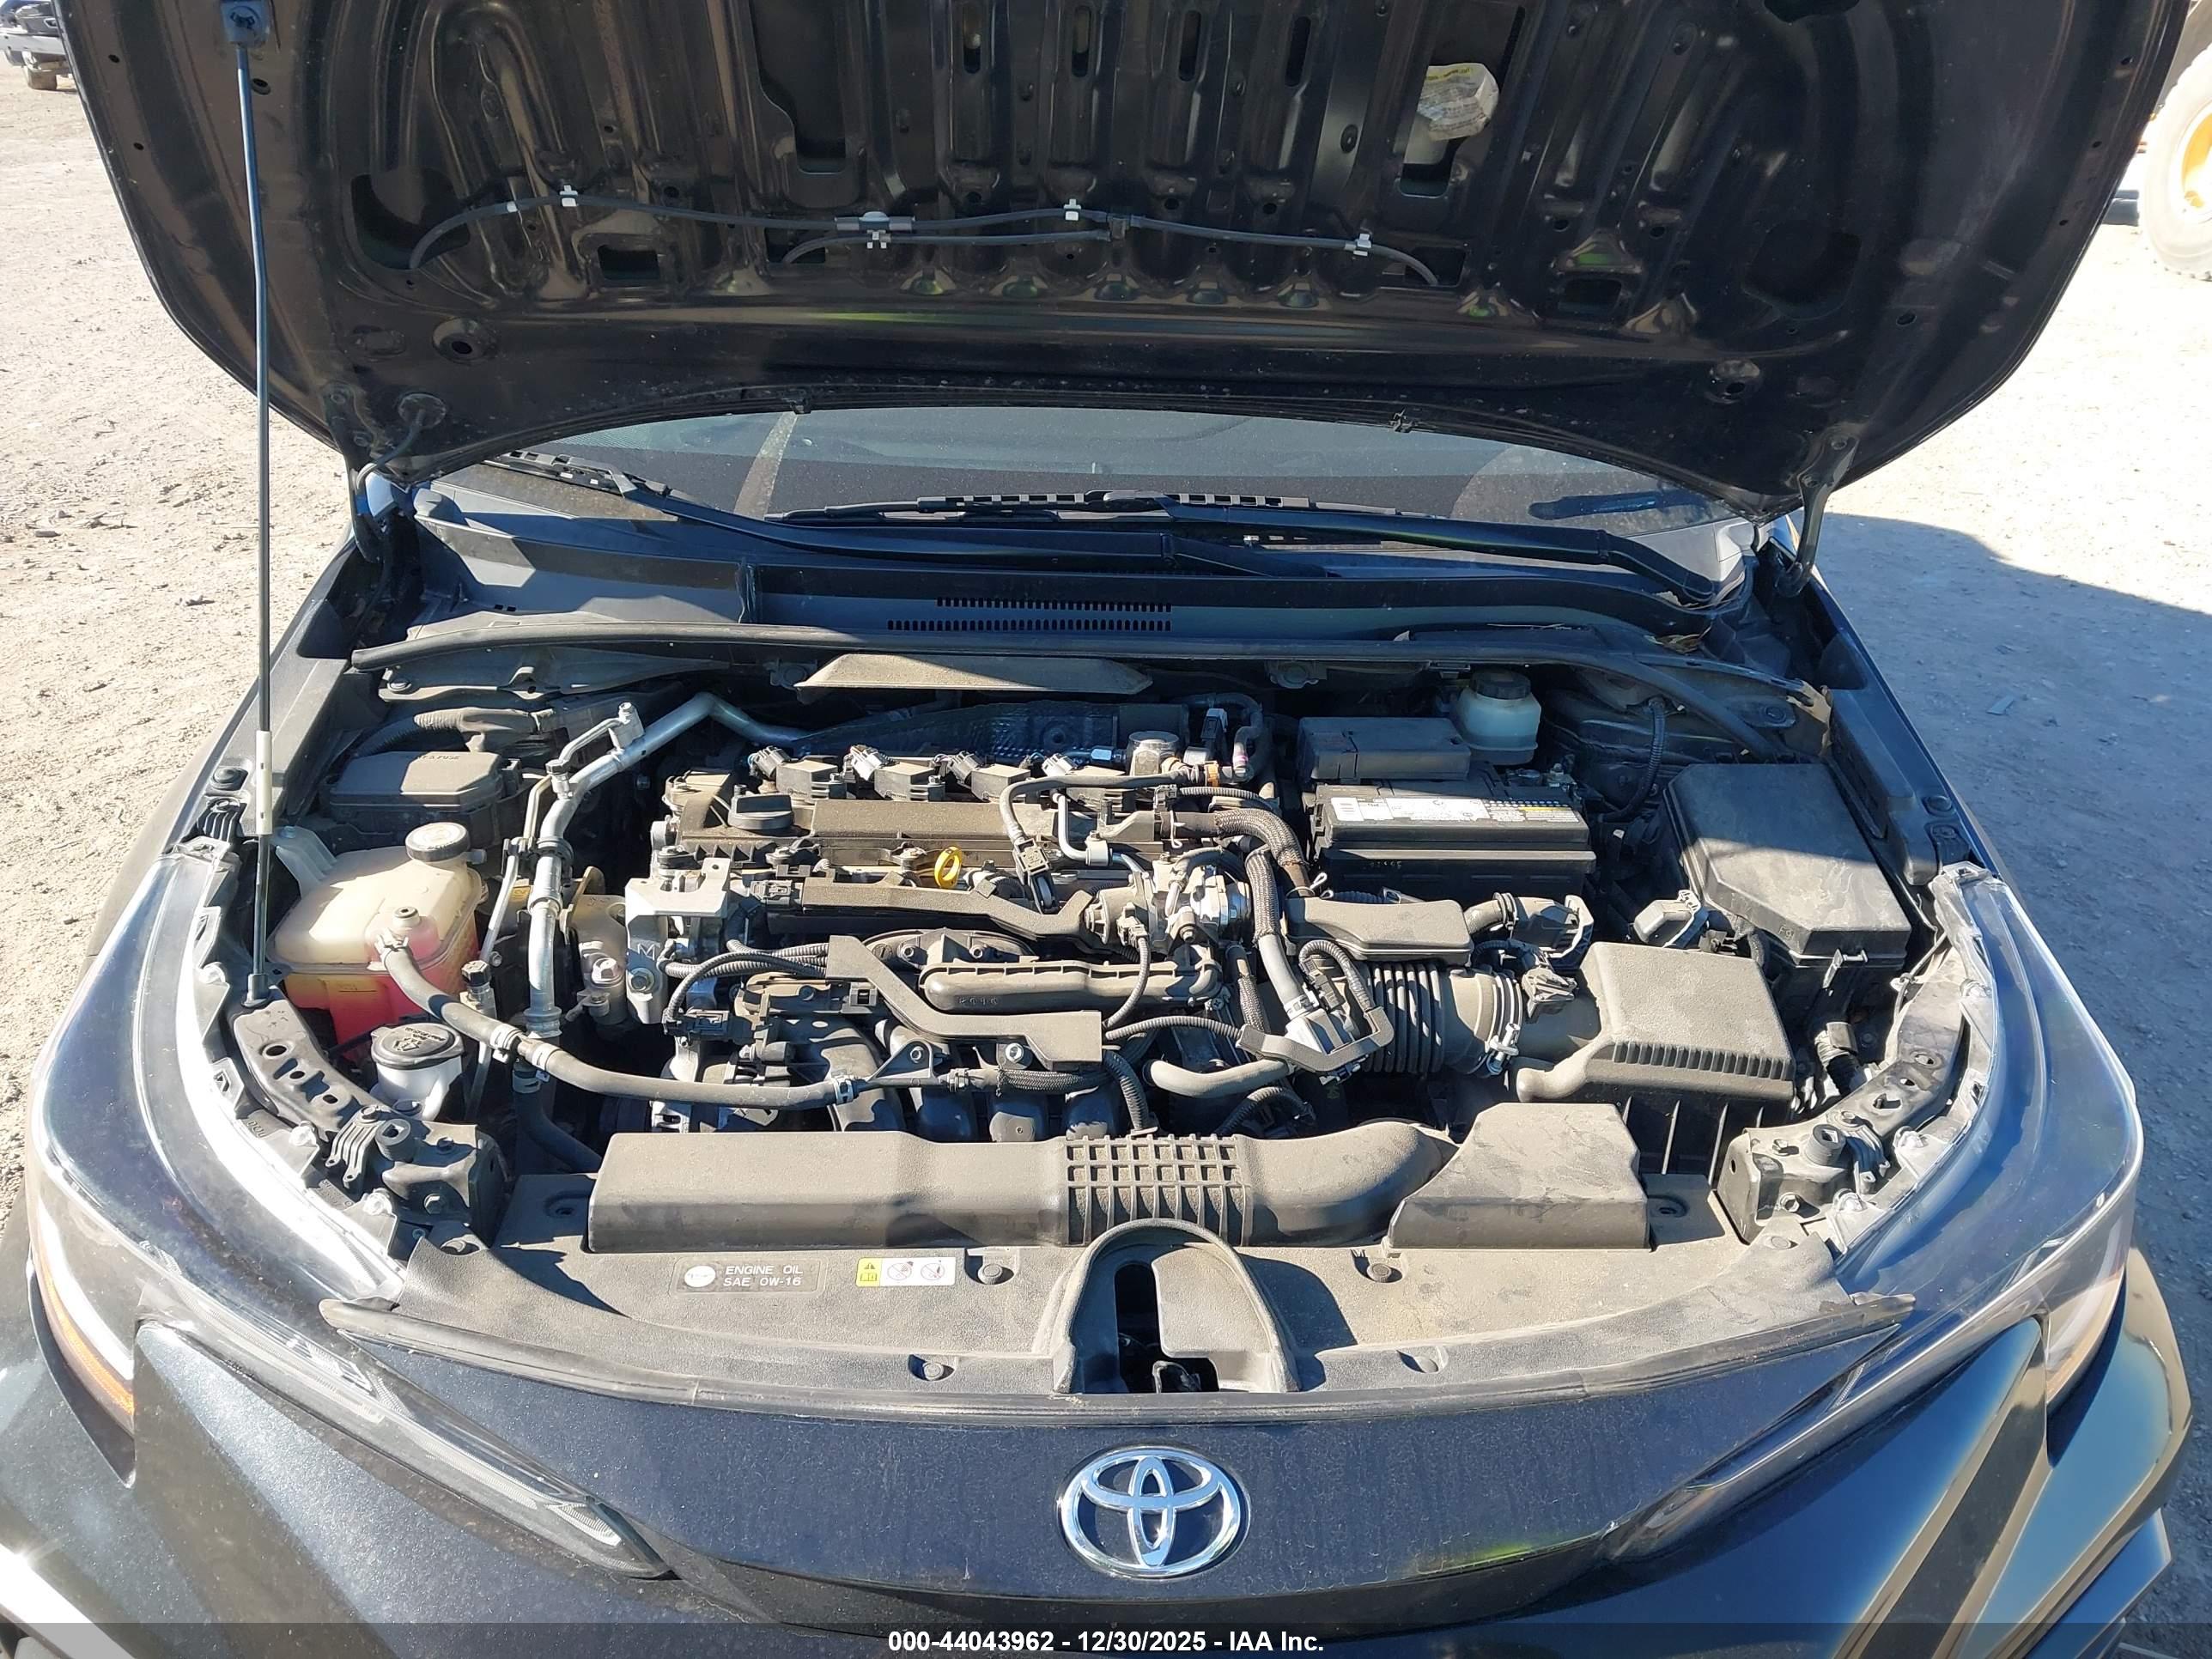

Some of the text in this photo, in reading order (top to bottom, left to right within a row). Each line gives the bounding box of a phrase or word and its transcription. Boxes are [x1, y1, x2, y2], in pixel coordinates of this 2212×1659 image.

[725, 1265, 804, 1275] ENGINE OIL
[723, 1277, 751, 1287] SAE
